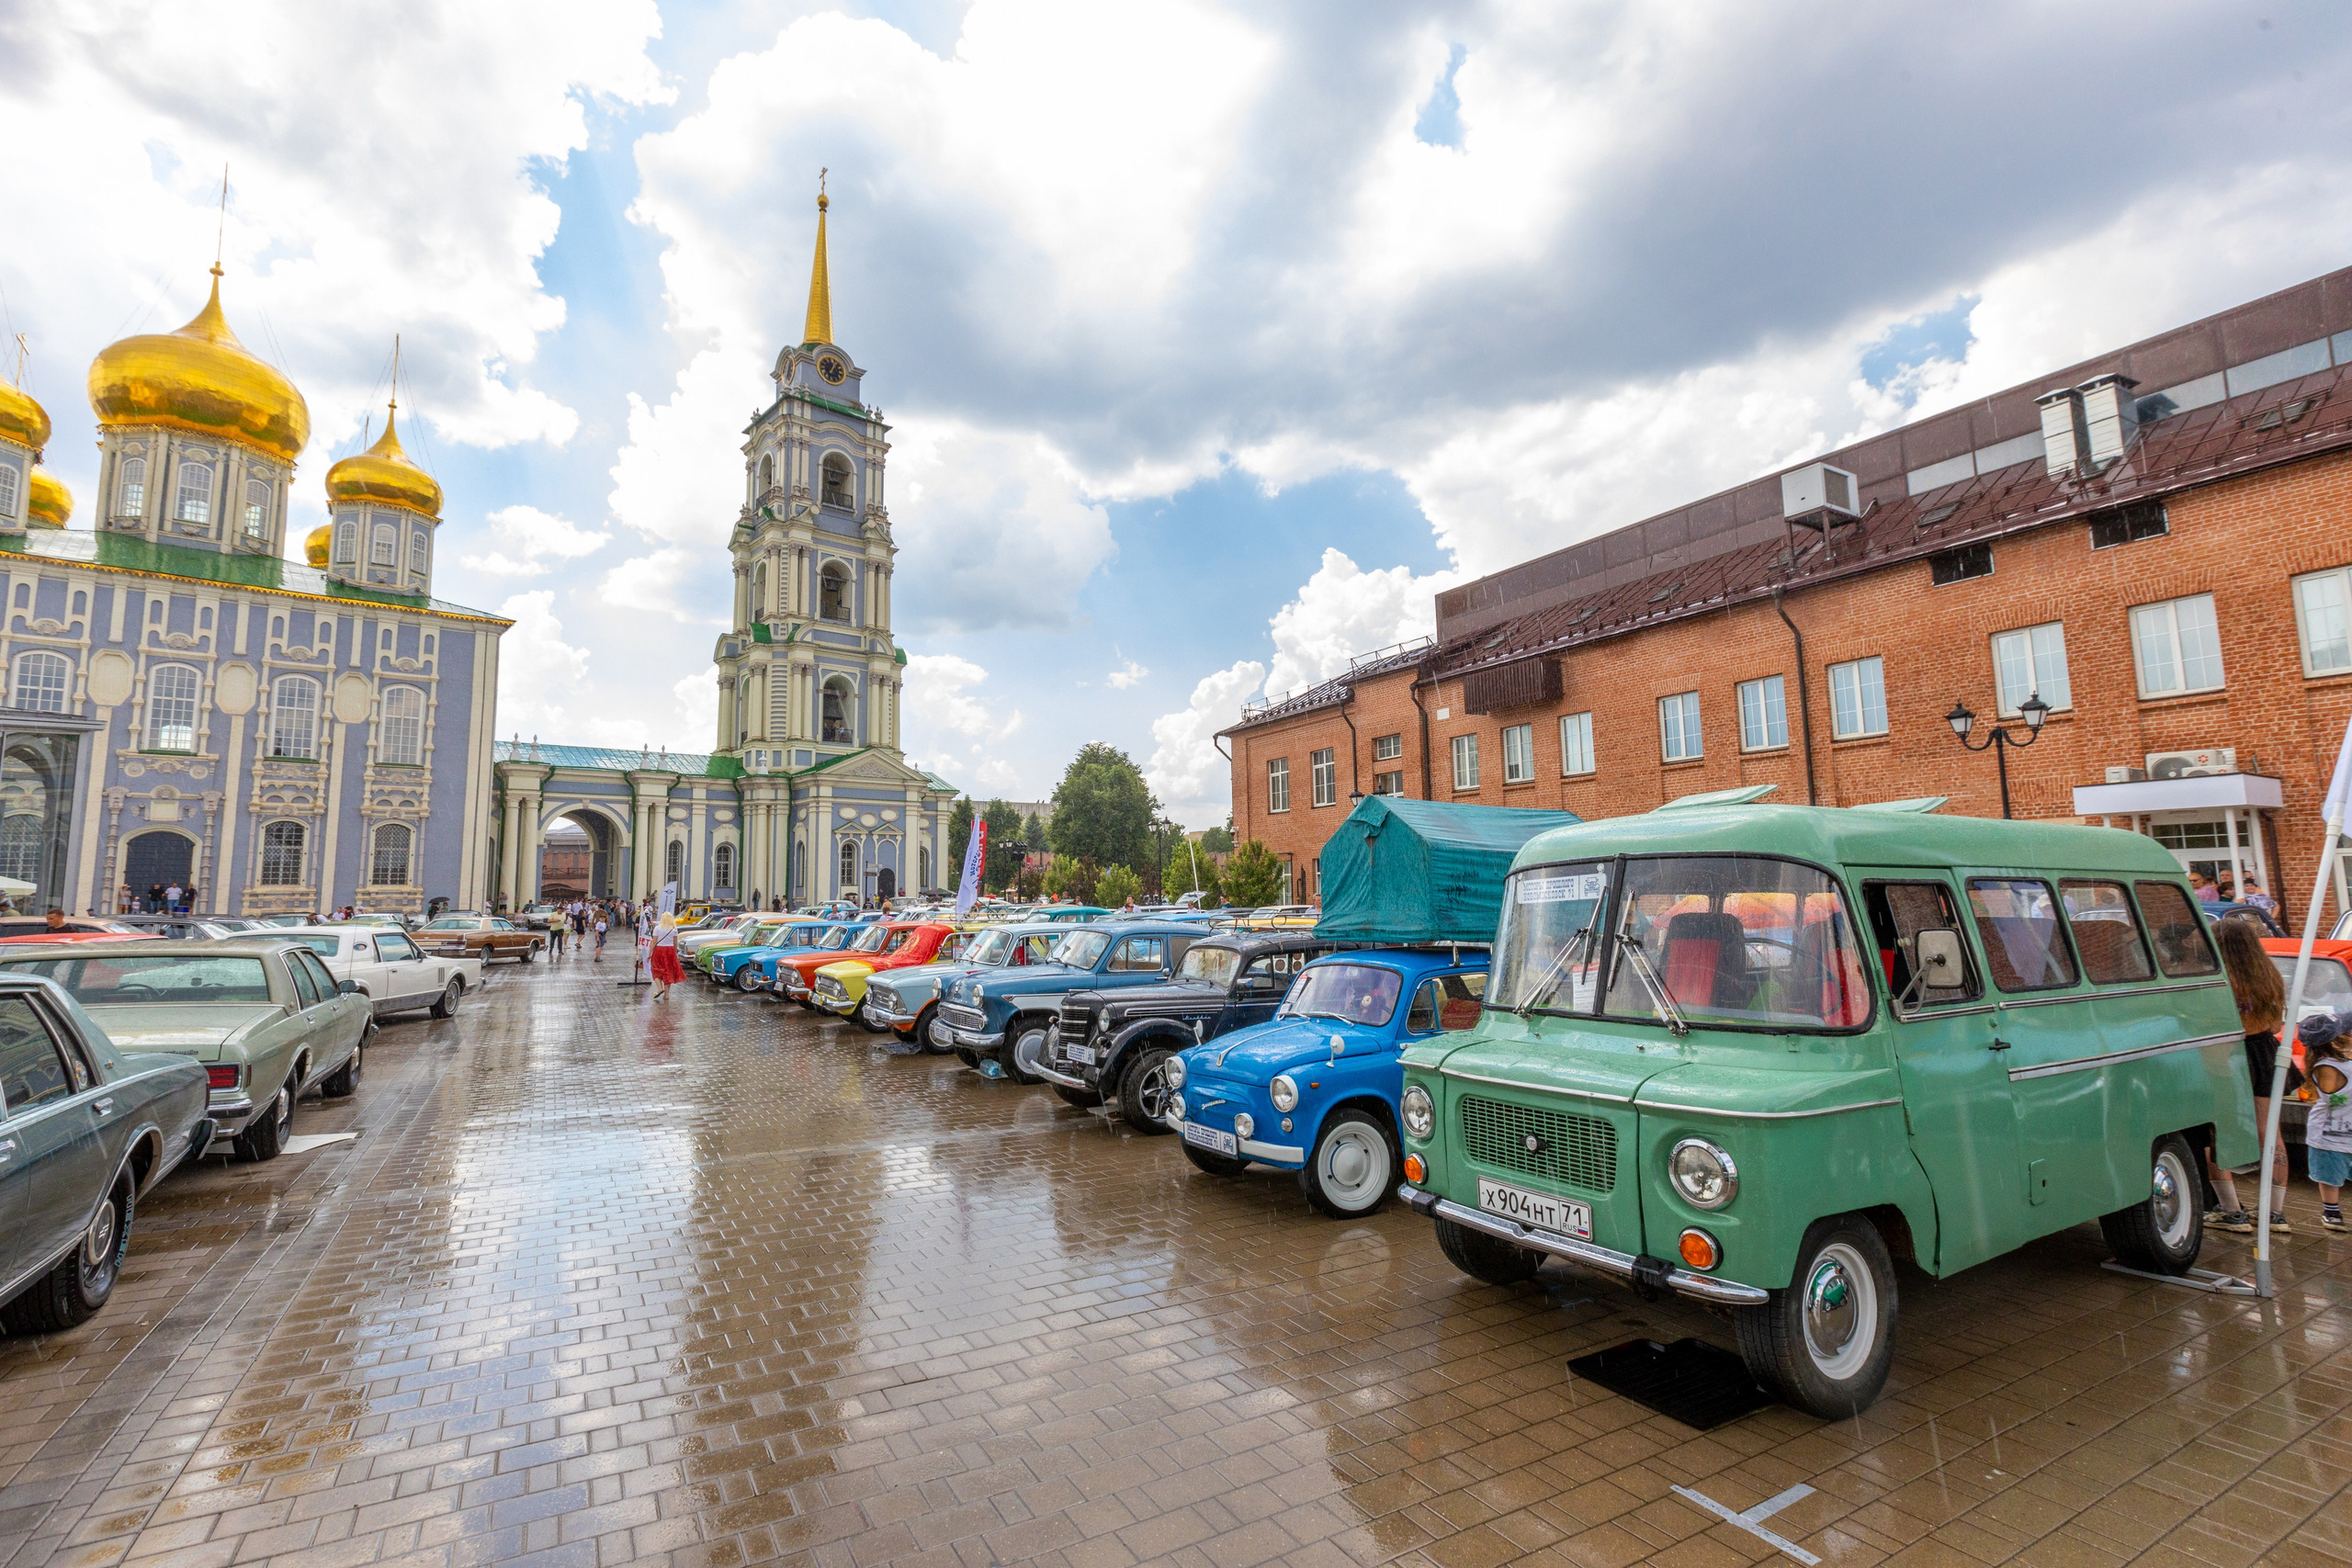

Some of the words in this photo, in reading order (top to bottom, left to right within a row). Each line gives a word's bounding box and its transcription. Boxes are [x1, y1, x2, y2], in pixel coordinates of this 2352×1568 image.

[1567, 888, 1575, 898] 71
[1486, 1188, 1555, 1225] Х904НТ
[1562, 1203, 1582, 1226] 71
[1562, 1222, 1577, 1233] RUS
